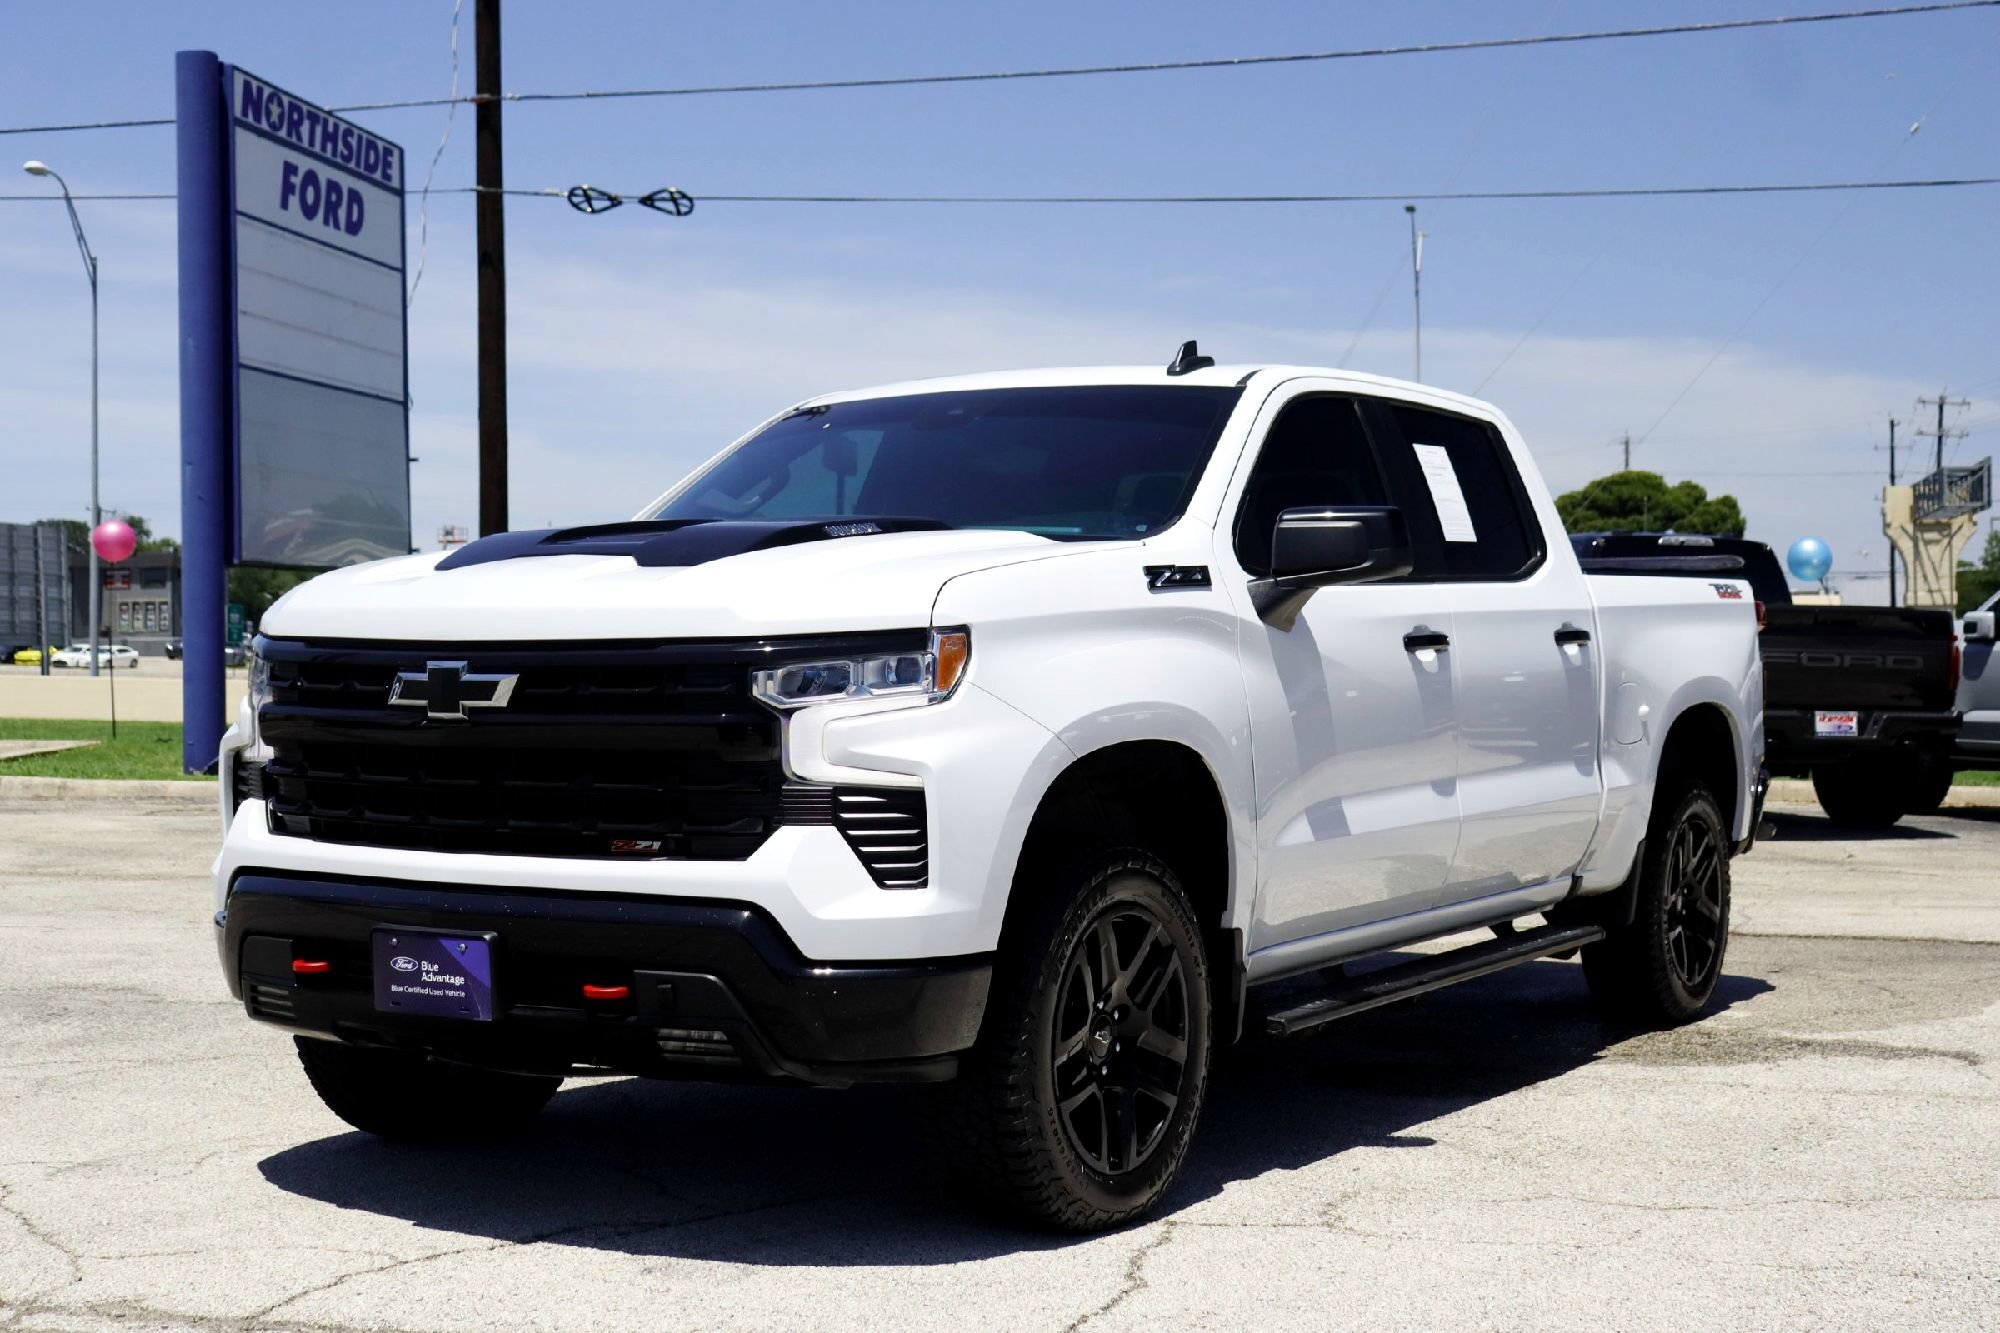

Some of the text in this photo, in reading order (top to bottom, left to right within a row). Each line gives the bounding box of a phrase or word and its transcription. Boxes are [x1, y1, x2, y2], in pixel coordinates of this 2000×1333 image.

[241, 78, 394, 183] NORTHSIDE
[280, 160, 365, 237] FORD
[1761, 652, 1923, 669] FORD
[421, 961, 439, 971] Blue
[421, 972, 465, 985] Advantage
[391, 984, 404, 992] Blue
[404, 985, 428, 994] Certified
[445, 989, 465, 997] Vehicle
